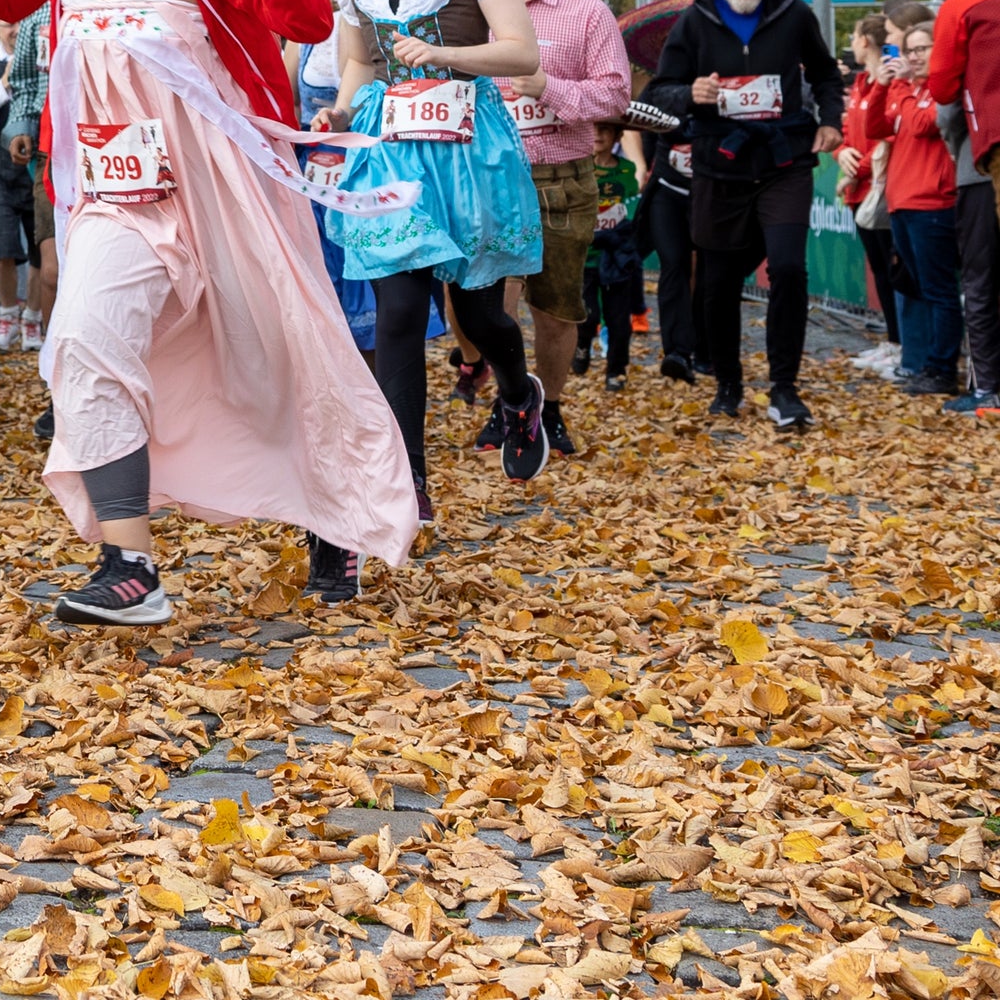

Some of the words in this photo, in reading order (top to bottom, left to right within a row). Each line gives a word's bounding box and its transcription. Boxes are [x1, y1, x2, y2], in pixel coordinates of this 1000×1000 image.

[740, 92, 759, 106] 32
[408, 101, 449, 121] 186
[512, 103, 546, 121] 193
[100, 155, 142, 180] 299
